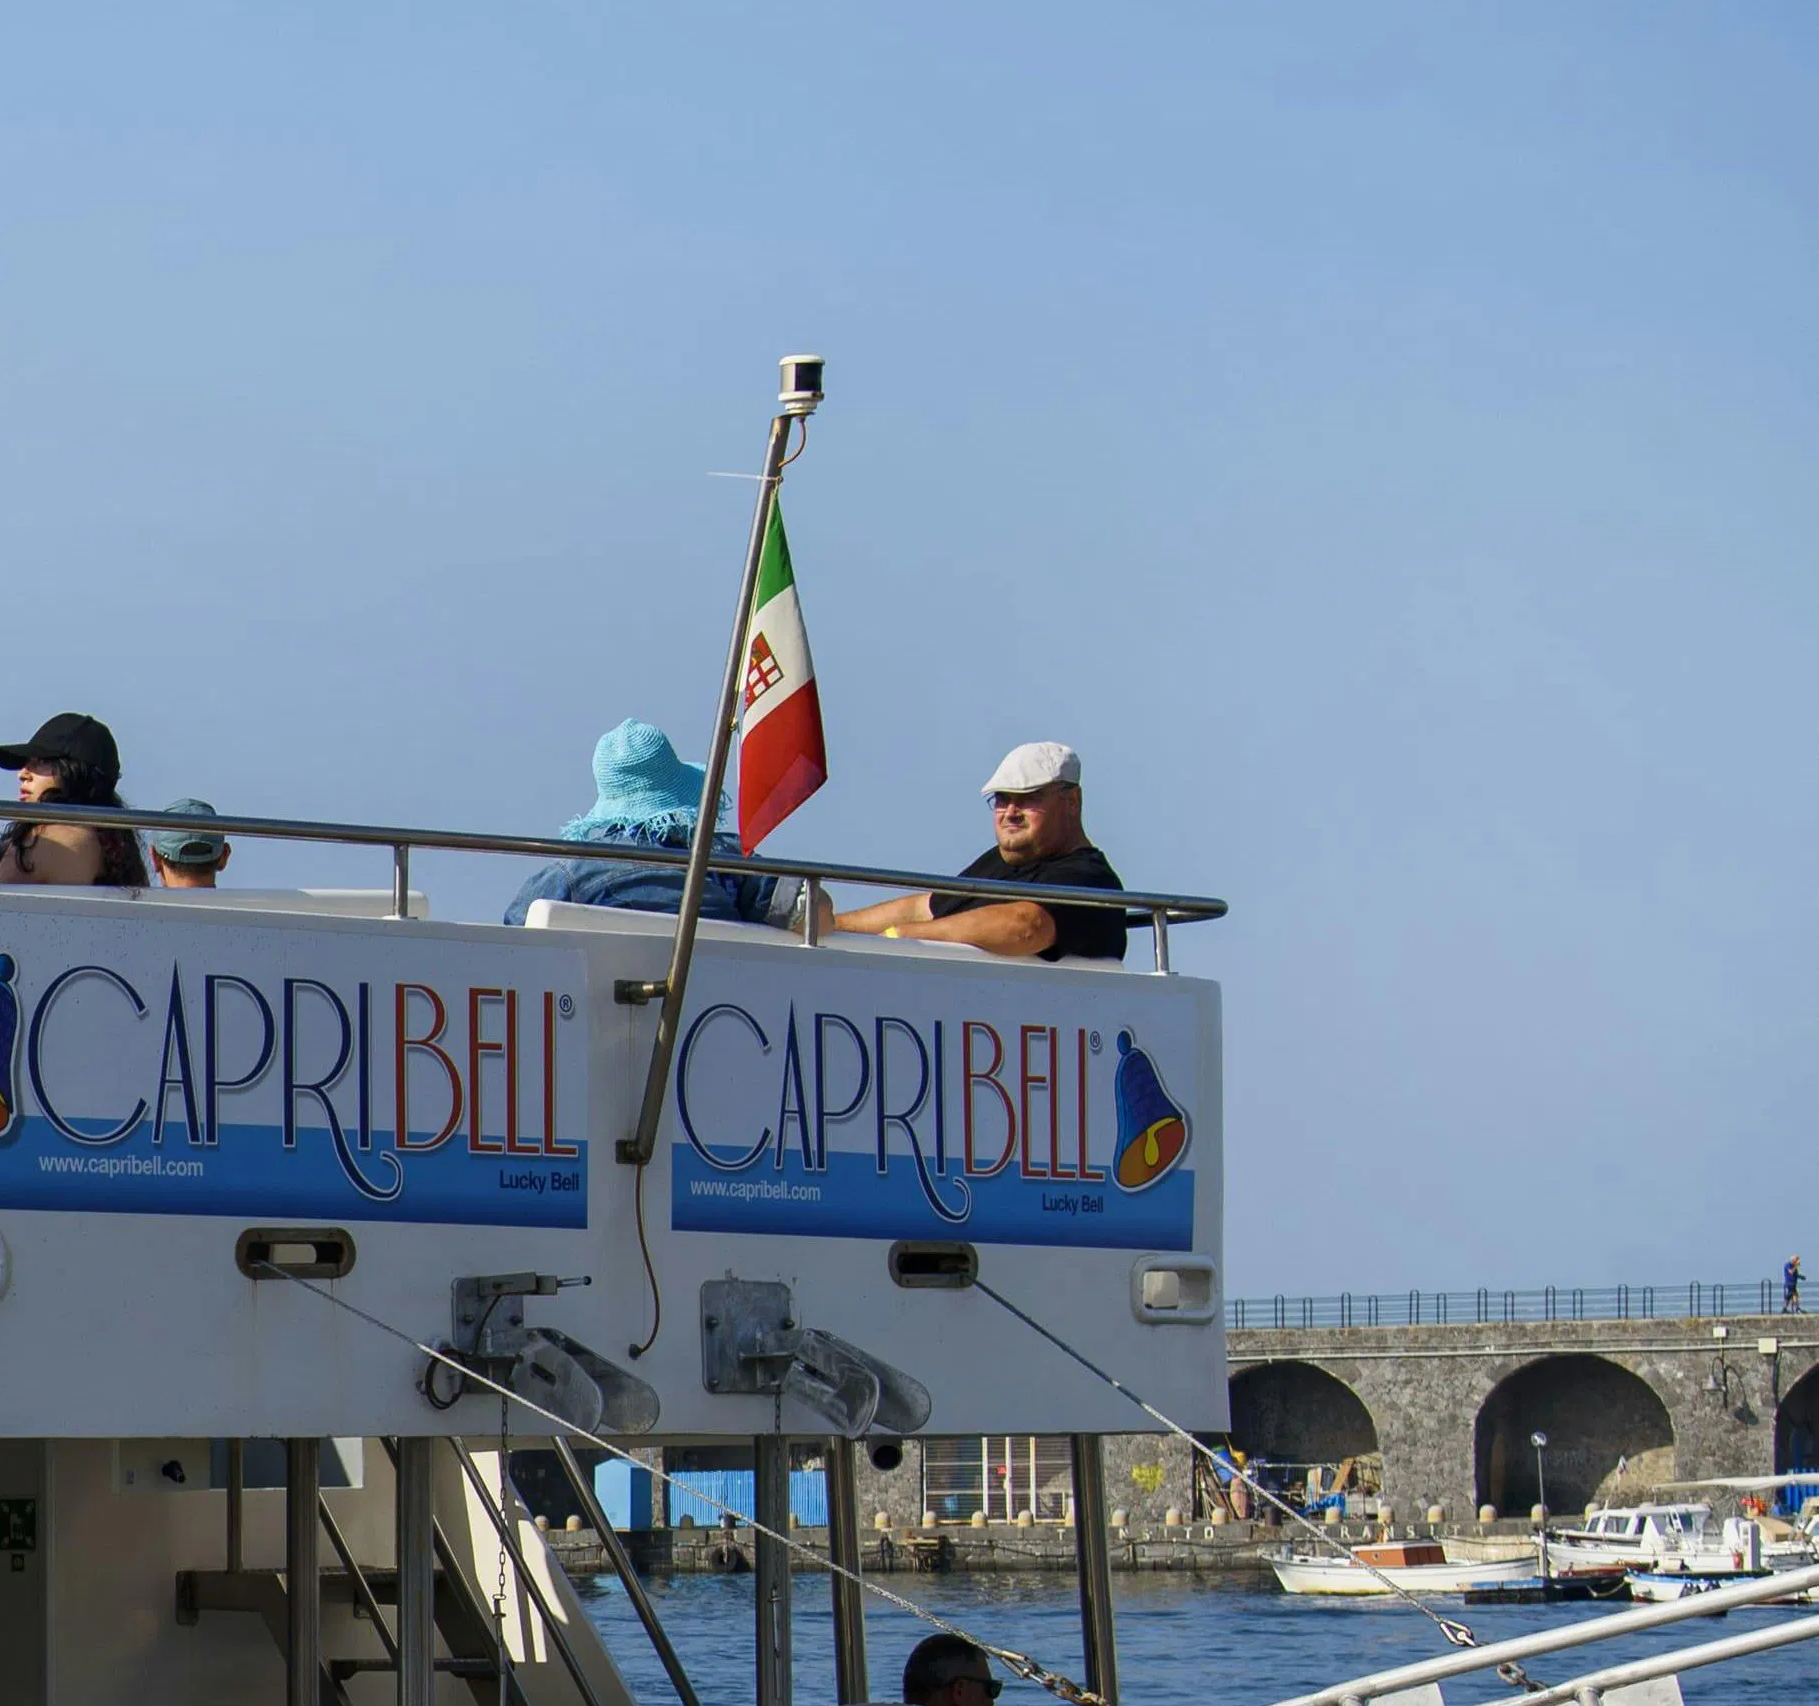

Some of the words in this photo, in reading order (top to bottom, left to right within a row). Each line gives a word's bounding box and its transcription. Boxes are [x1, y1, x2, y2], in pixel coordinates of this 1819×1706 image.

[27, 961, 578, 1198] CAPRIBELL
[676, 1000, 1104, 1221] CAPRIBELL
[38, 1154, 204, 1179] www.capribell.com
[500, 1169, 546, 1195] Lucky
[551, 1172, 579, 1191] Bell
[690, 1180, 821, 1202] www.capribell.com
[1042, 1193, 1079, 1214] Lucky
[1082, 1195, 1104, 1213] Bell
